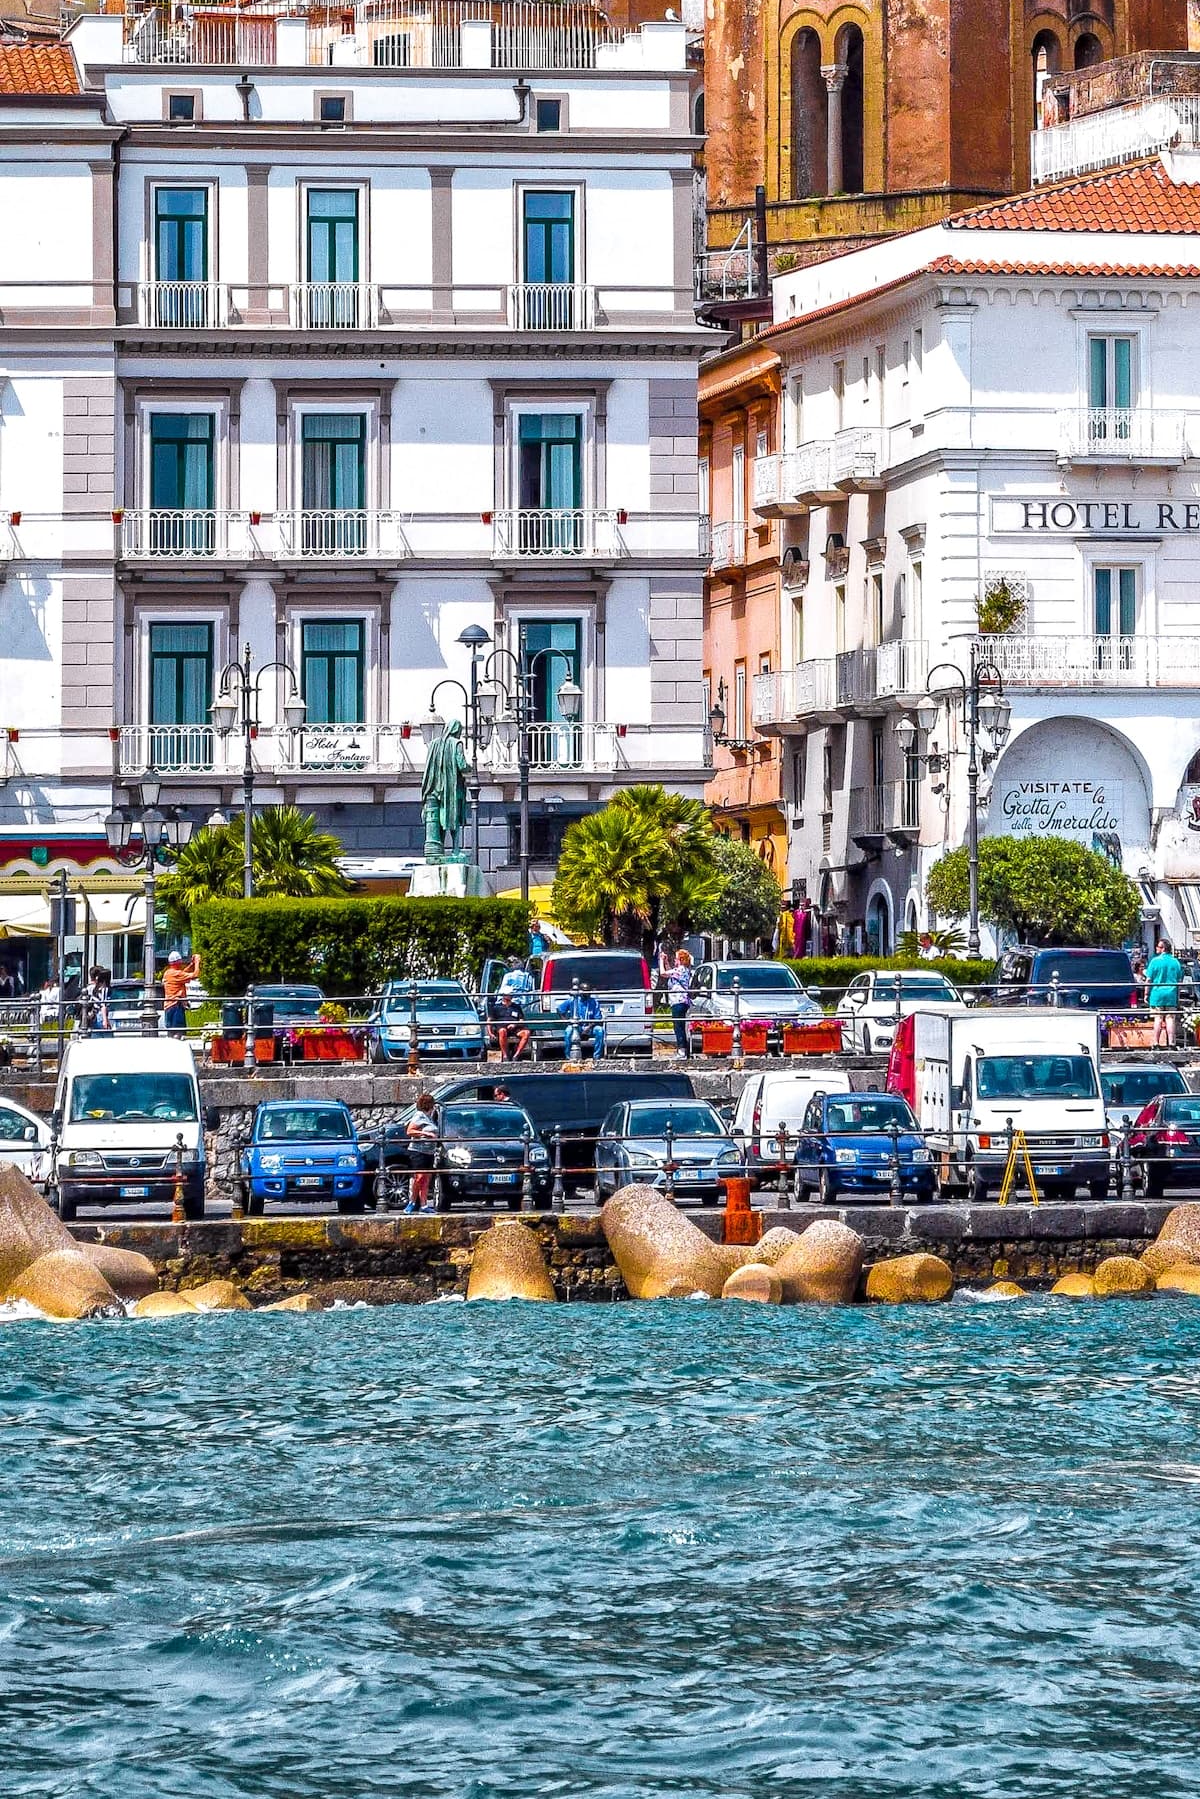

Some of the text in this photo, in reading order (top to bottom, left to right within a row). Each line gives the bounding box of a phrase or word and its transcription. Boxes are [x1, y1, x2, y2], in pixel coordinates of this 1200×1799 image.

[1021, 502, 1140, 528] HOTEL
[306, 737, 339, 749] Hotel
[1003, 790, 1050, 819] Grotta
[1020, 782, 1105, 804] VISITATE la
[1038, 801, 1119, 830] Smeraldo
